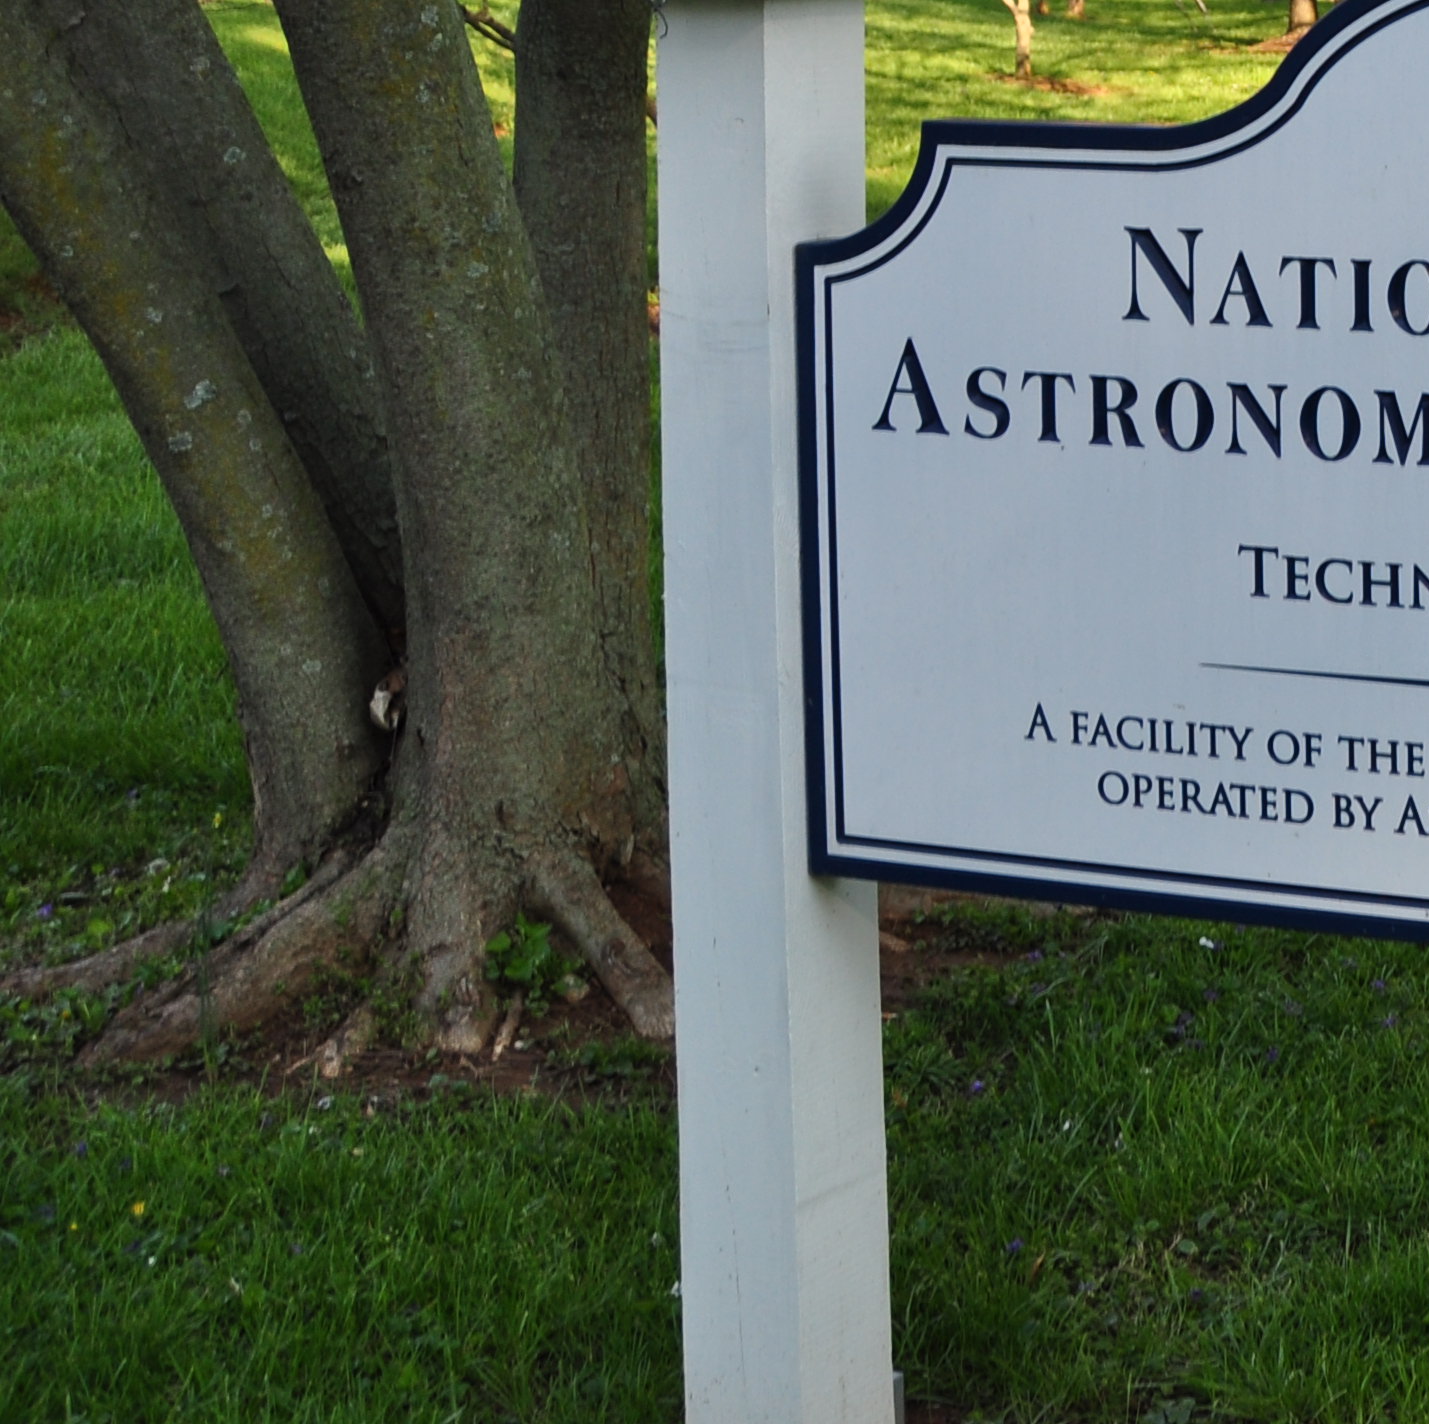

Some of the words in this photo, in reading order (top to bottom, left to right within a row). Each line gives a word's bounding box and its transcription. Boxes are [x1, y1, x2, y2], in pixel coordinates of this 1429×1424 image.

[1024, 701, 1058, 744] A
[1069, 710, 1255, 762] FACILITY
[1266, 728, 1324, 769] OF
[1336, 734, 1426, 778] THE
[1096, 770, 1316, 825] OPERATED
[1331, 792, 1384, 832] BY
